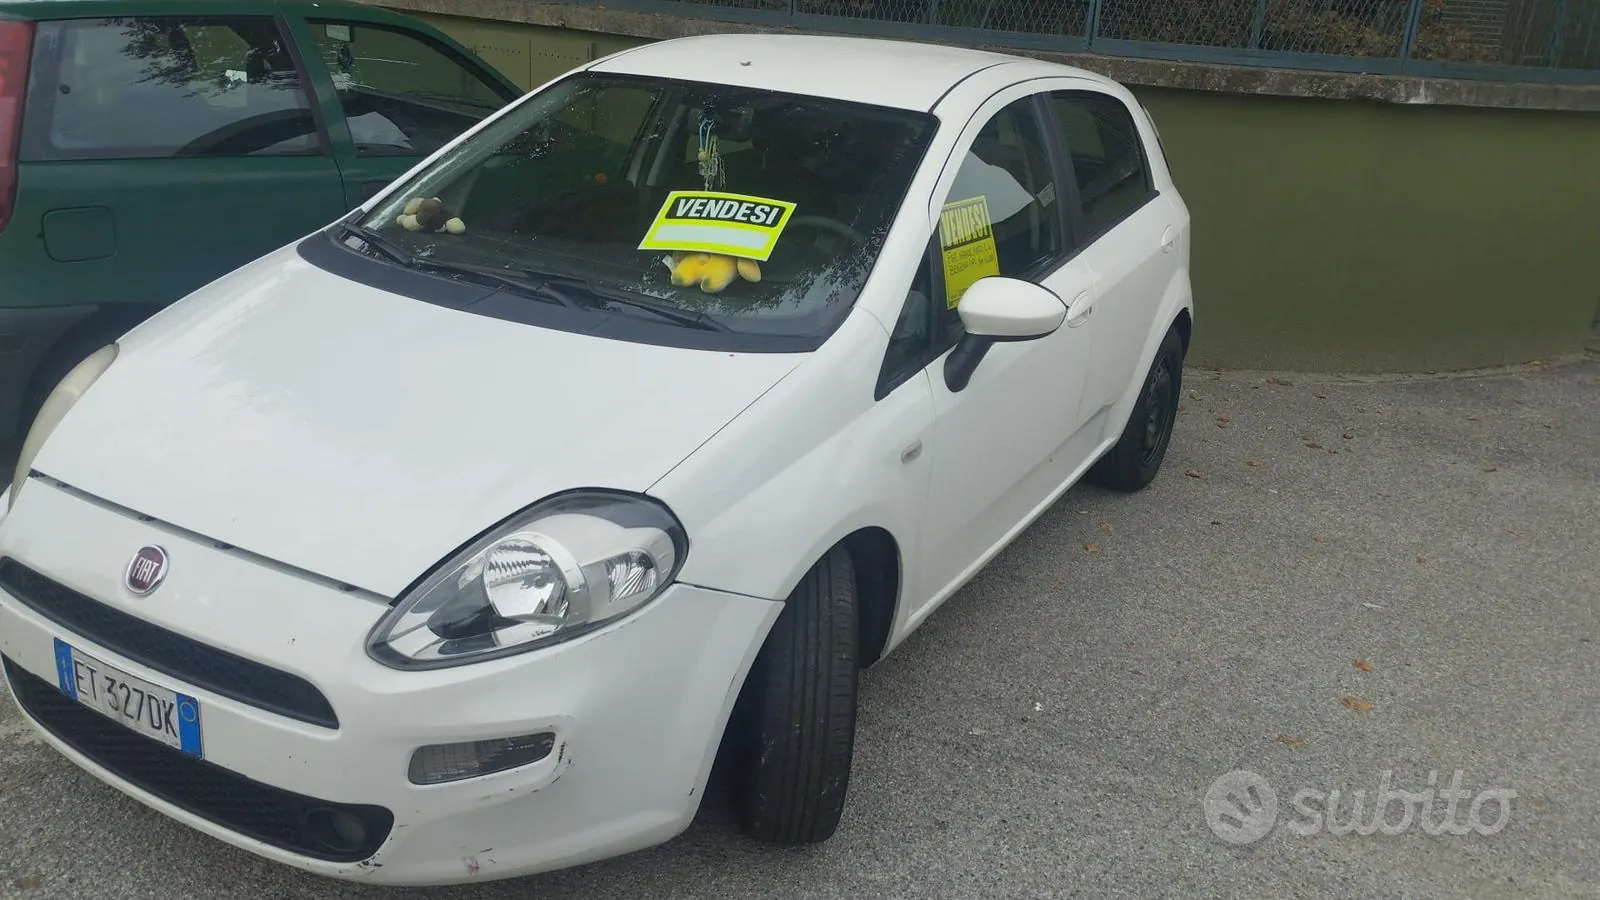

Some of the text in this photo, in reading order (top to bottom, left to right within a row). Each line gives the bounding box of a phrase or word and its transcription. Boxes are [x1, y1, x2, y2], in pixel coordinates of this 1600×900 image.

[676, 198, 779, 225] VENDESI
[941, 203, 988, 248] VENDESI
[132, 557, 160, 583] FIAT
